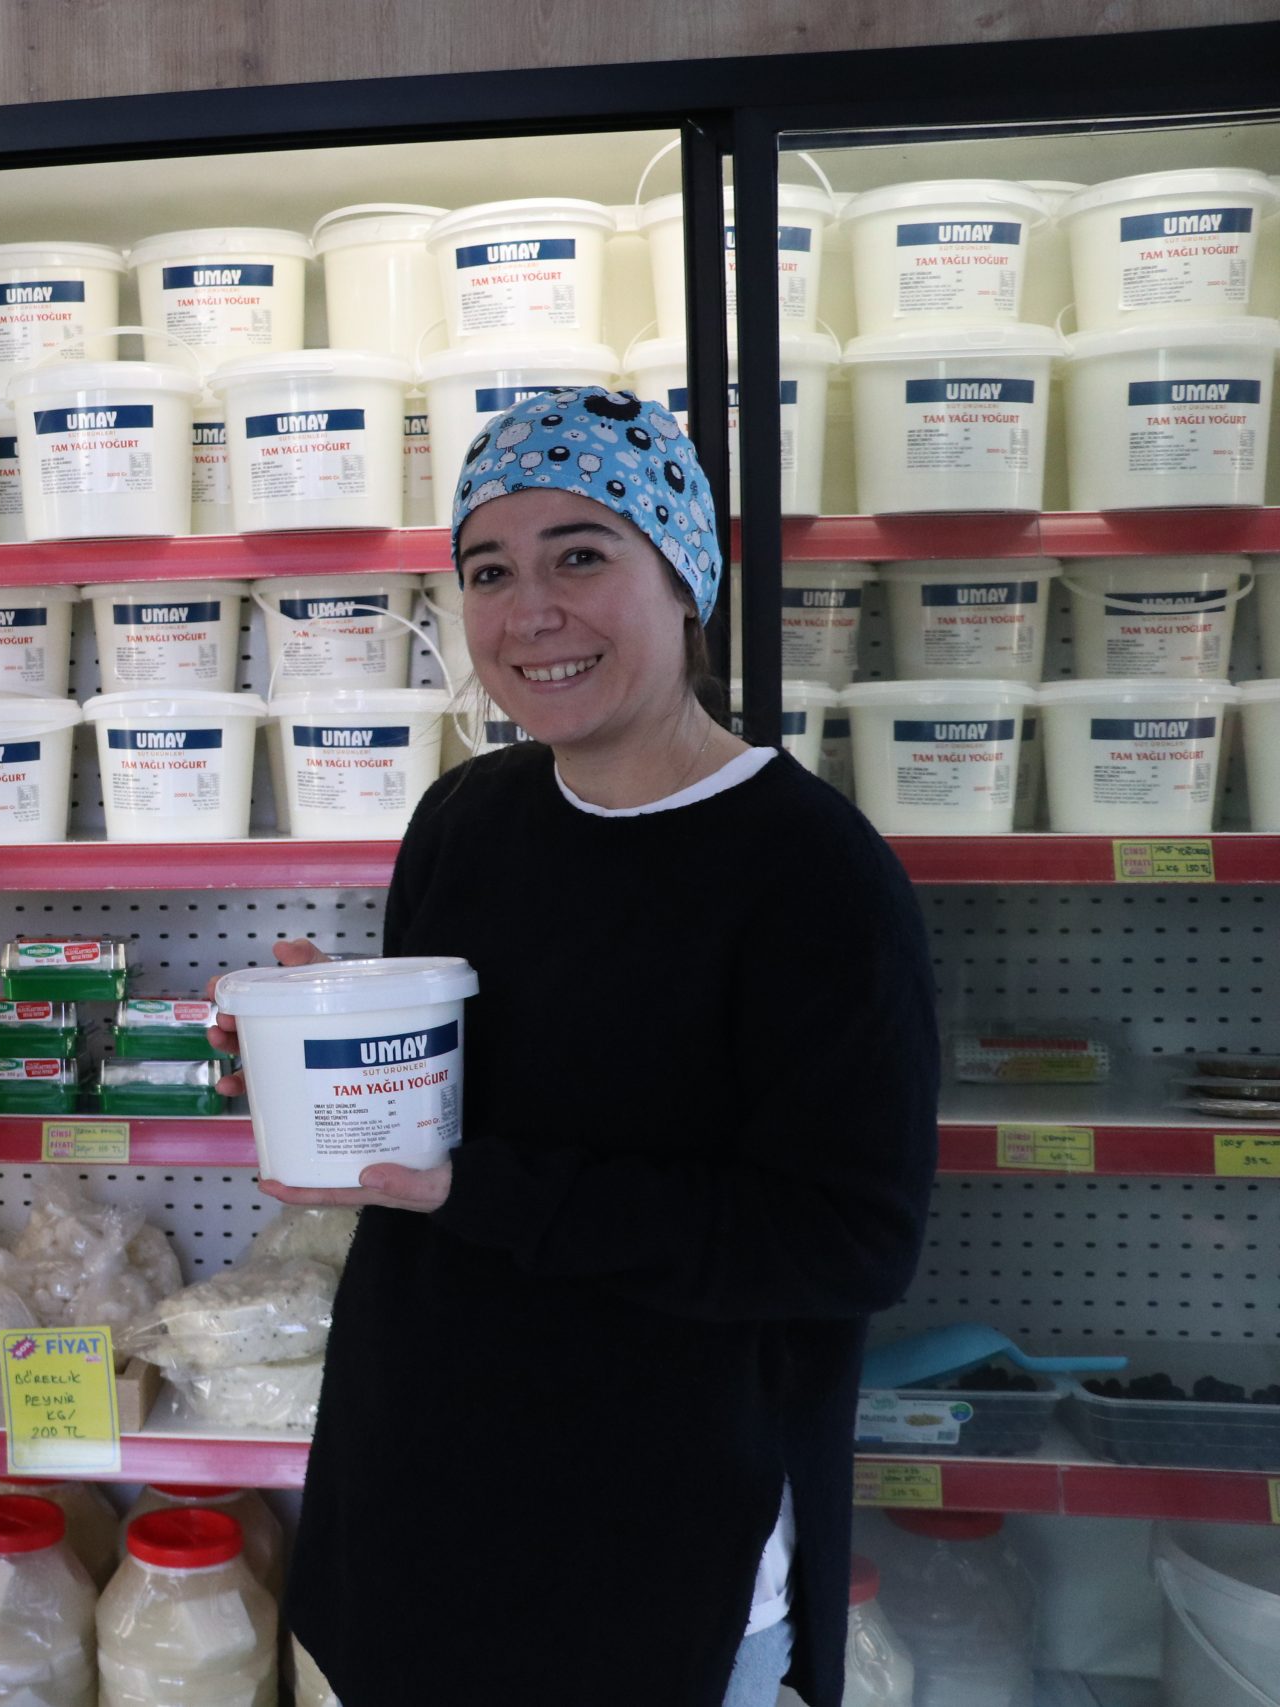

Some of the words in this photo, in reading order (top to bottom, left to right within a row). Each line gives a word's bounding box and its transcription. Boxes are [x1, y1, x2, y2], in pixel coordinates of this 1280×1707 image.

[1164, 214, 1222, 234] UMAY
[939, 225, 993, 242] UMAY
[487, 242, 540, 262] UMAY
[1140, 251, 1163, 260] TAM
[1166, 247, 1198, 257] YAĞLI
[1201, 244, 1238, 255] YOĞURT
[916, 257, 937, 266] TAM
[941, 255, 970, 264] YAĞLI
[974, 255, 1008, 265] YOĞURT
[193, 270, 241, 285] UMAY
[6, 287, 53, 303] UMAY
[946, 383, 1001, 400] UMAY
[1171, 384, 1230, 402] UMAY
[67, 411, 117, 430] UMAY
[276, 413, 328, 433] UMAY
[923, 414, 944, 423] TAM
[948, 412, 978, 423] YAĞLI
[981, 412, 1020, 423] YOĞURT
[1147, 416, 1170, 426] TAM
[1173, 414, 1205, 425] YAĞLI
[1208, 414, 1247, 425] YOĞURT
[262, 448, 278, 456] TAM
[281, 445, 308, 454] YAĞLI
[310, 442, 350, 452] YOĞURT
[803, 591, 845, 606] UMAY
[957, 588, 1008, 603] UMAY
[142, 607, 188, 622] UMAY
[308, 602, 355, 617] UMAY
[935, 723, 988, 740] UMAY
[1133, 721, 1188, 738] UMAY
[136, 732, 186, 748] UMAY
[322, 730, 373, 746] UMAY
[360, 1034, 427, 1064] UMAY
[362, 1068, 380, 1076] SÜT
[383, 1062, 427, 1075] ÜRÜNLERİ
[333, 1085, 362, 1096] TAM
[366, 1079, 404, 1095] YAĞLI
[407, 1069, 449, 1089] YOĞURT
[417, 1119, 432, 1128] 2000
[46, 1334, 100, 1354] FİYAT
[25, 1393, 75, 1406] PEYNİR
[31, 1426, 58, 1439] 200
[64, 1425, 85, 1438] TL
